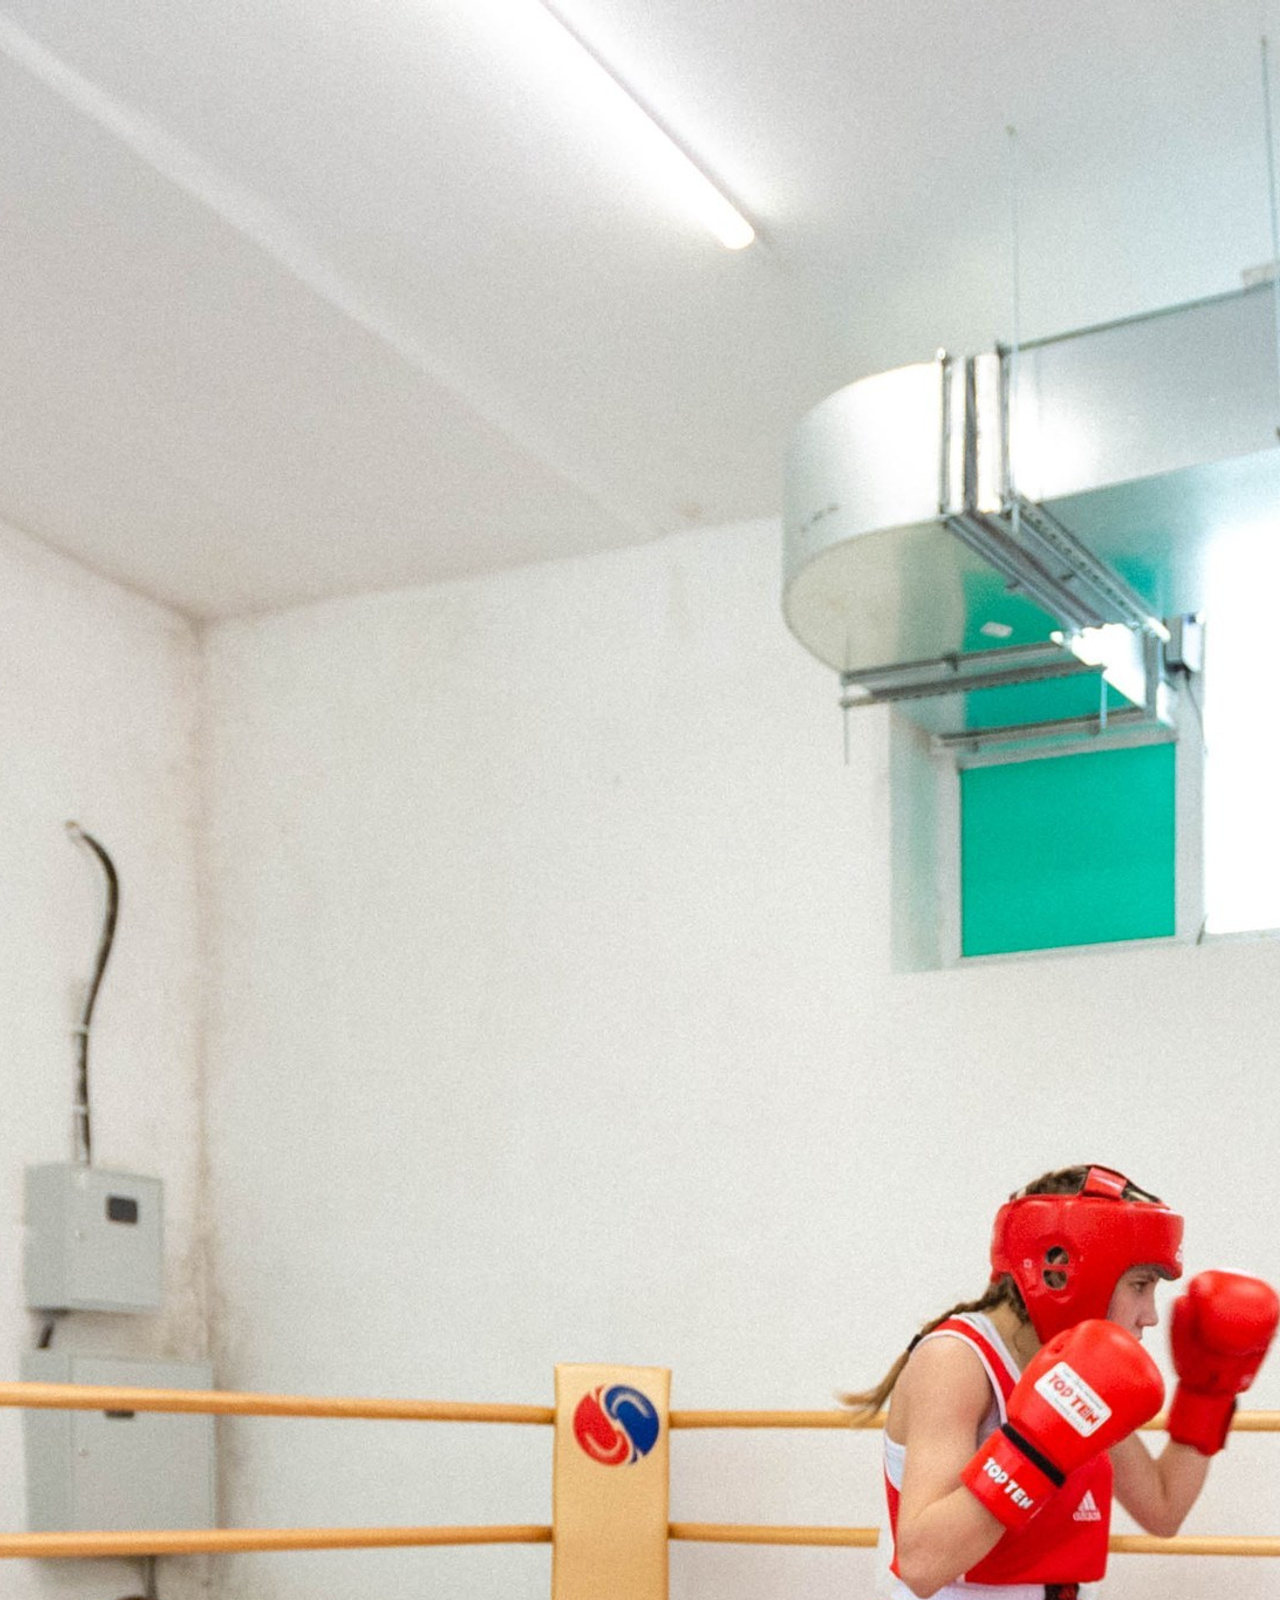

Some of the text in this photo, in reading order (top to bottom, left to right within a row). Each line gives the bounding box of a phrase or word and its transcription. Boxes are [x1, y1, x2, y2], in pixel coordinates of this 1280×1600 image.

[1048, 1373, 1074, 1398] TOP
[1070, 1395, 1099, 1425] TEN
[982, 1456, 1034, 1510] TOP TEN
